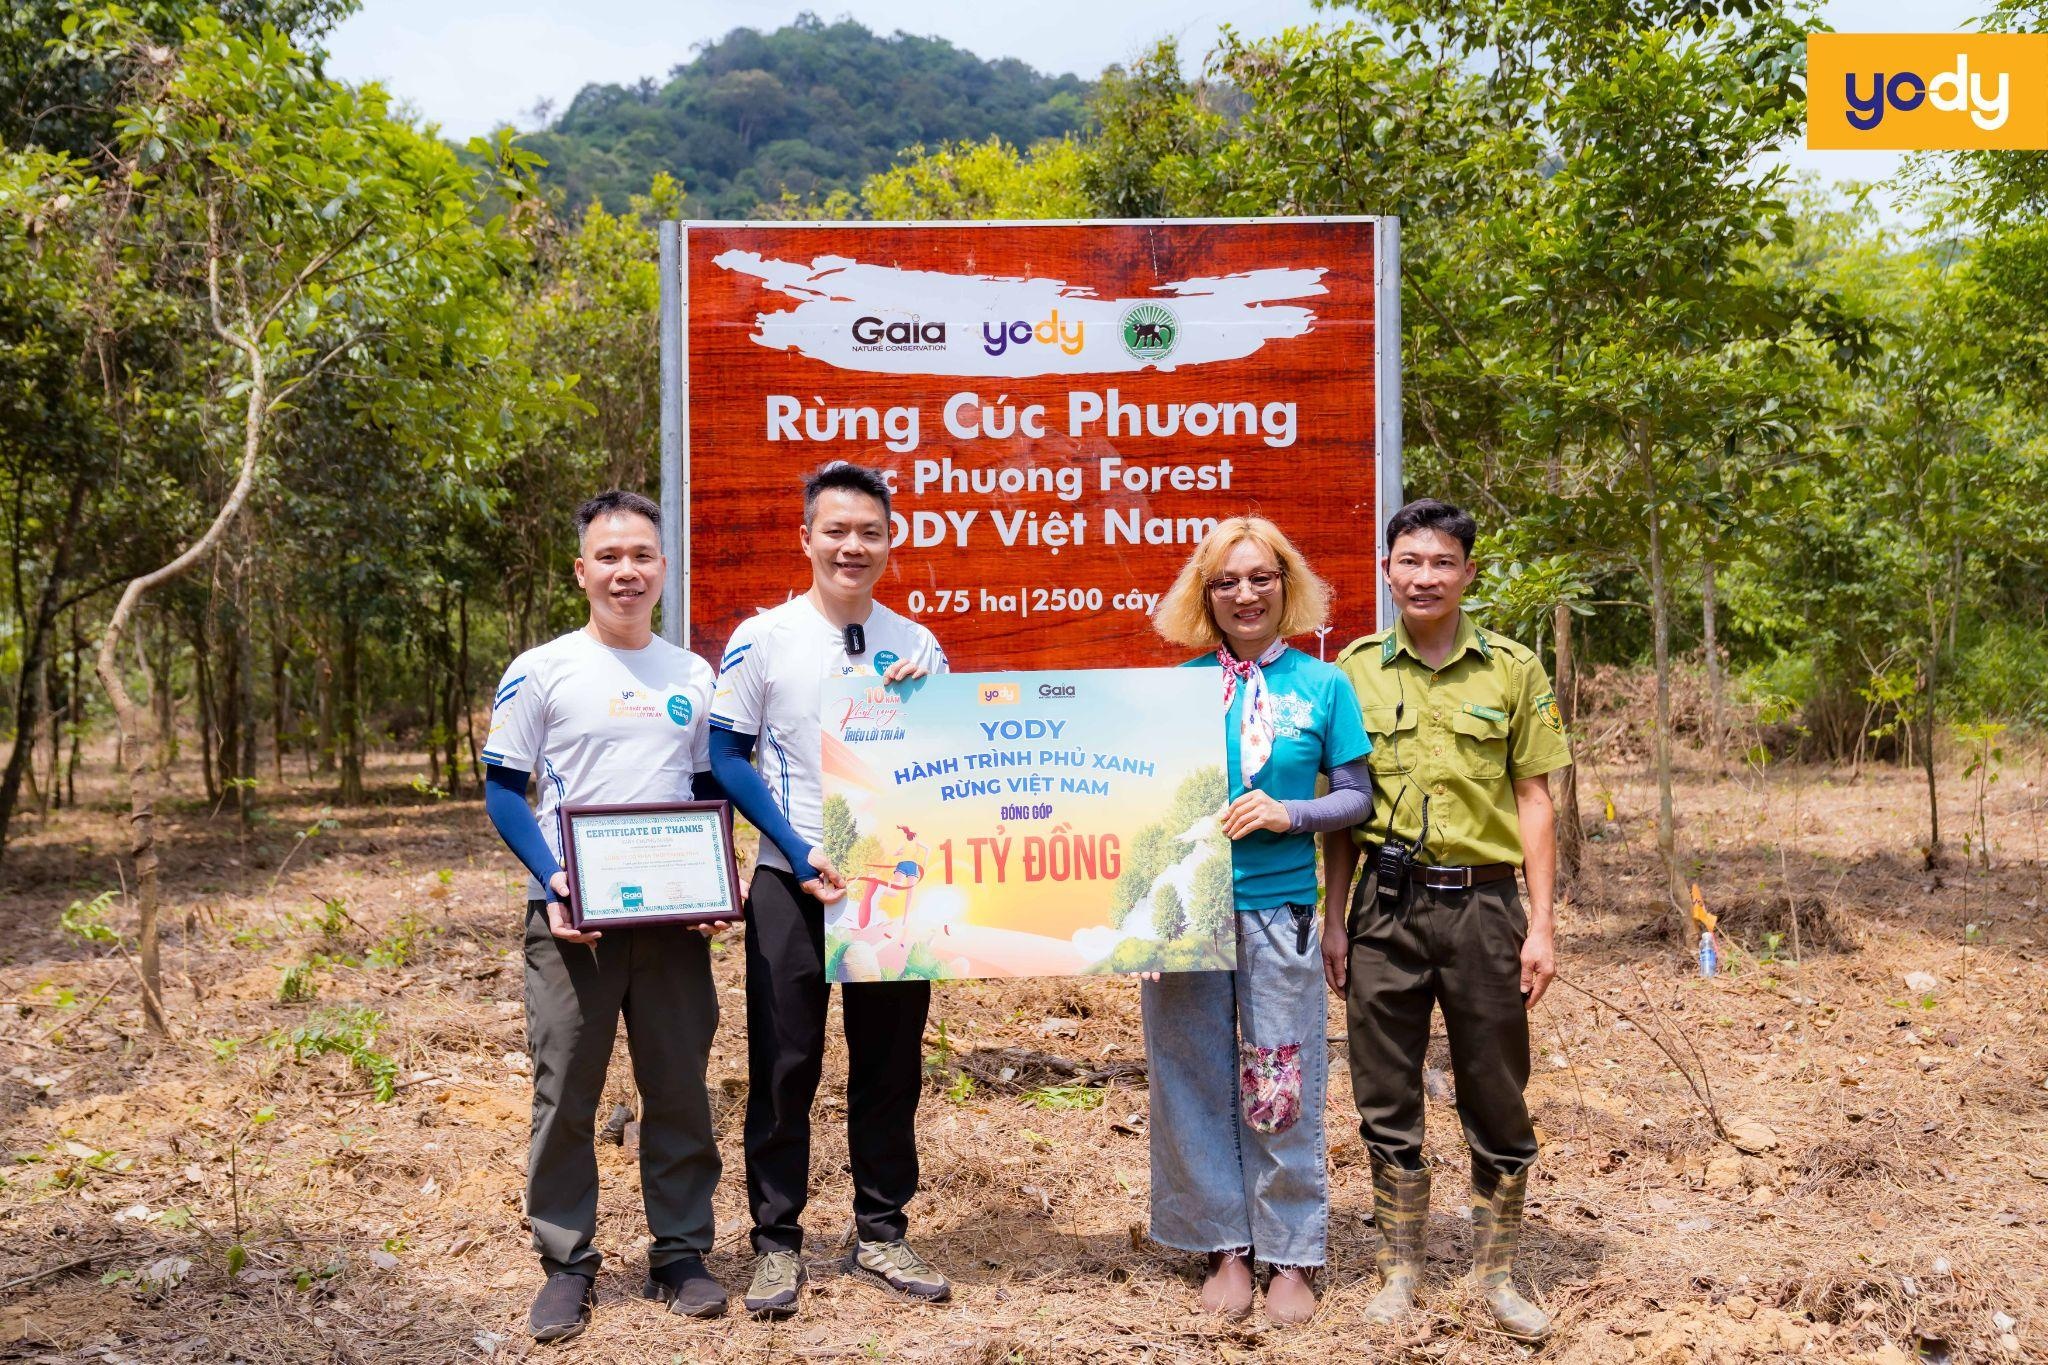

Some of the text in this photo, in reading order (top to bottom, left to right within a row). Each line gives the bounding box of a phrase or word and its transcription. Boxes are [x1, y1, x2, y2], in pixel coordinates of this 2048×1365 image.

[852, 314, 946, 345] Gaia
[983, 309, 1085, 357] yody
[886, 344, 946, 352] CONSERVATION
[766, 389, 1297, 452] Rừng Cúc Phương
[914, 457, 1083, 501] Phuong
[1100, 457, 1233, 492] Forest
[989, 509, 1088, 555] Việt
[1104, 508, 1218, 545] Nam
[908, 589, 970, 613] 0.75
[1112, 588, 1160, 616] cây
[865, 687, 885, 704] 10
[985, 686, 1014, 701] yody
[1038, 683, 1076, 696] Gaia
[980, 719, 1067, 740] YODY
[894, 747, 1155, 785] HÀNH TRÌNH PHỦ XANH
[940, 773, 1110, 801] RỪNG VIỆT NAM
[1001, 802, 1053, 820] ĐÓNG GÓP
[586, 825, 704, 838] CERTIFICATE OF THANKS
[939, 821, 1121, 884] 1 TỶ ĐỒNG
